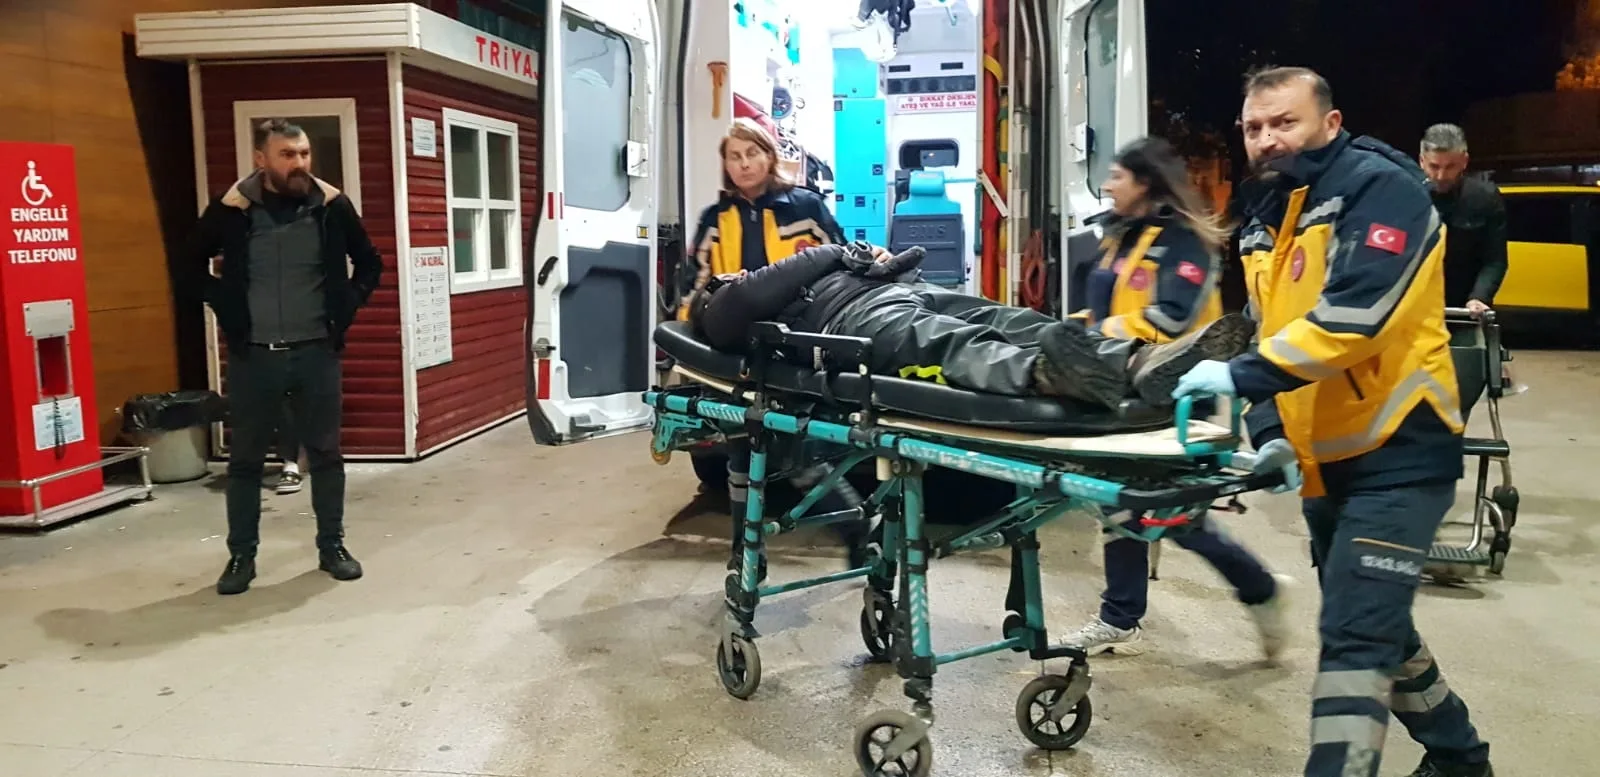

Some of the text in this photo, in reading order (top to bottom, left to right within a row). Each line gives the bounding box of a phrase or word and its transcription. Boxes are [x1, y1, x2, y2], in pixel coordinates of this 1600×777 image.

[11, 204, 68, 222] ENGELLİ
[13, 228, 69, 243] YARDIM
[8, 247, 77, 264] TELEFONU
